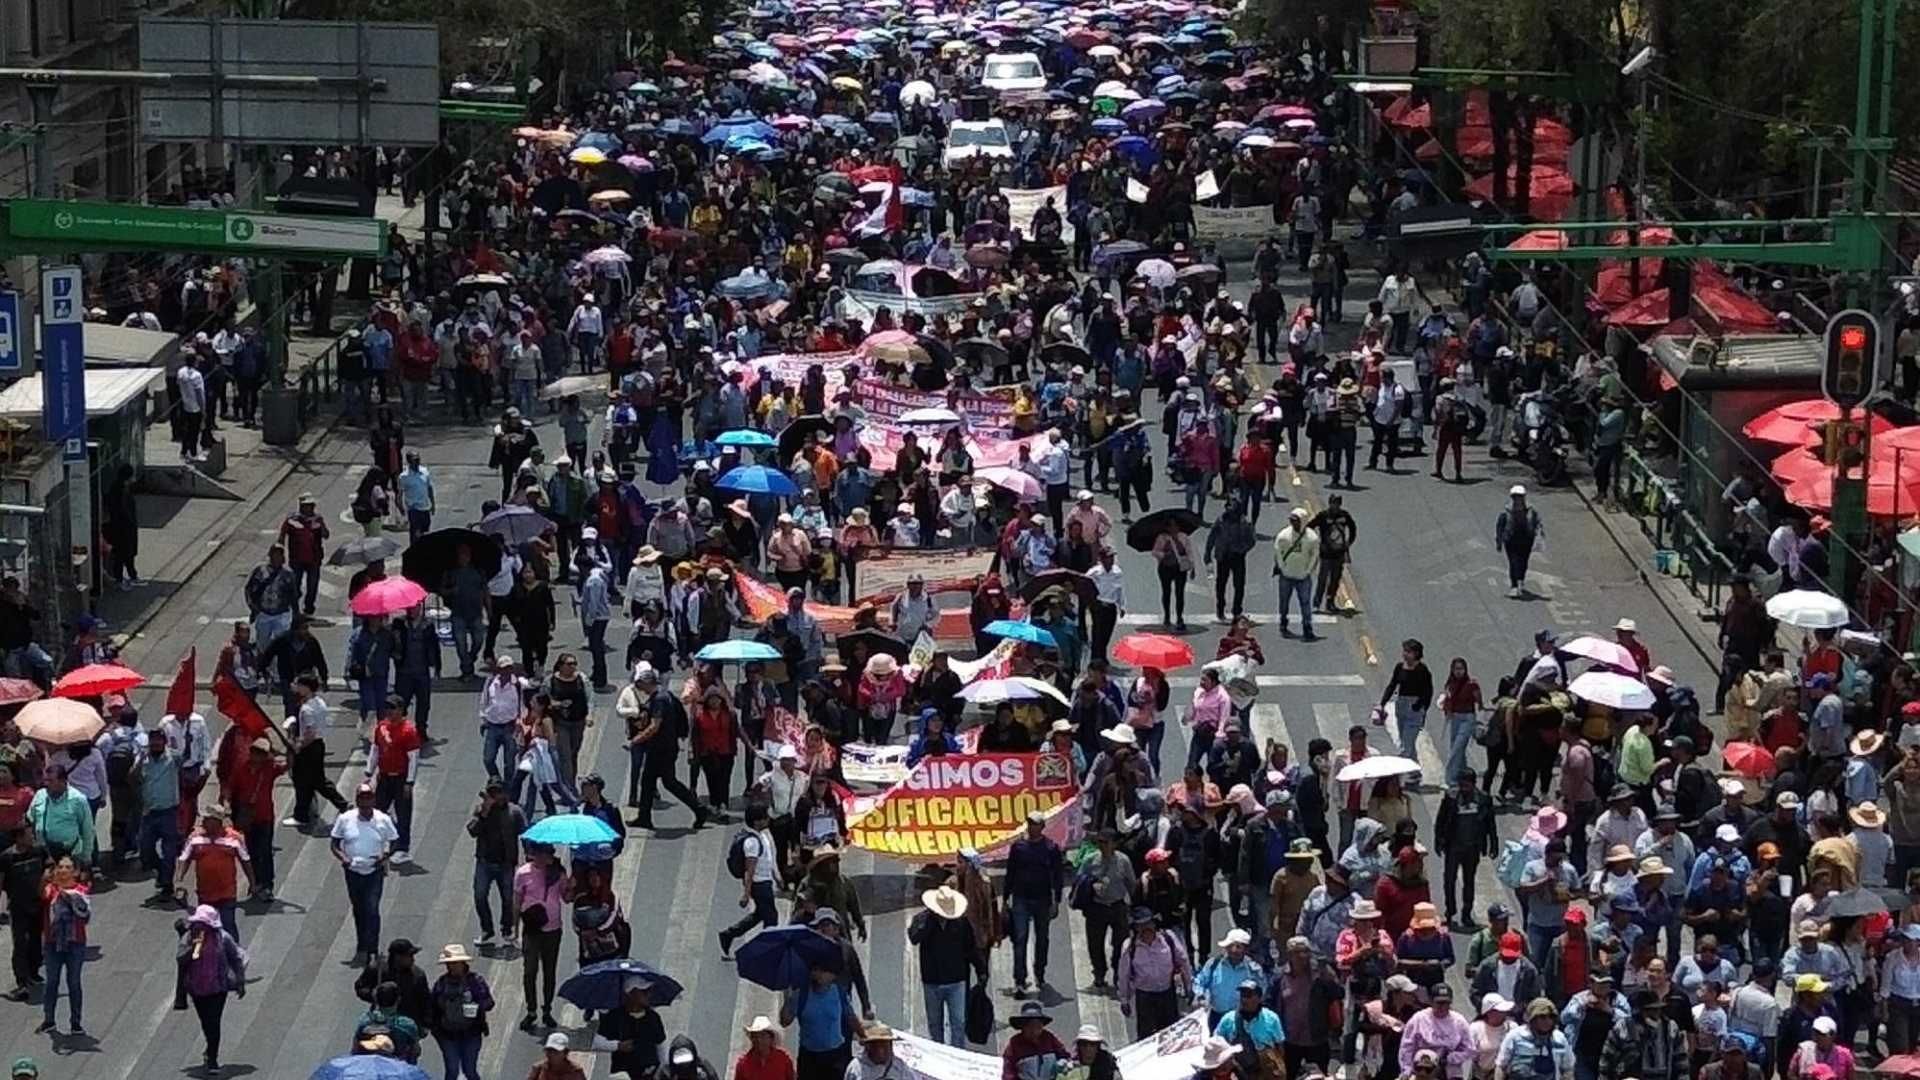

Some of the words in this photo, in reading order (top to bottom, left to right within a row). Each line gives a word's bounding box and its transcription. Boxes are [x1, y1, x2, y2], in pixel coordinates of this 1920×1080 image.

[899, 758, 1024, 790] GIMOS
[855, 788, 1064, 829] SIFICACIÓN
[852, 828, 1017, 857] INMEDIAT
